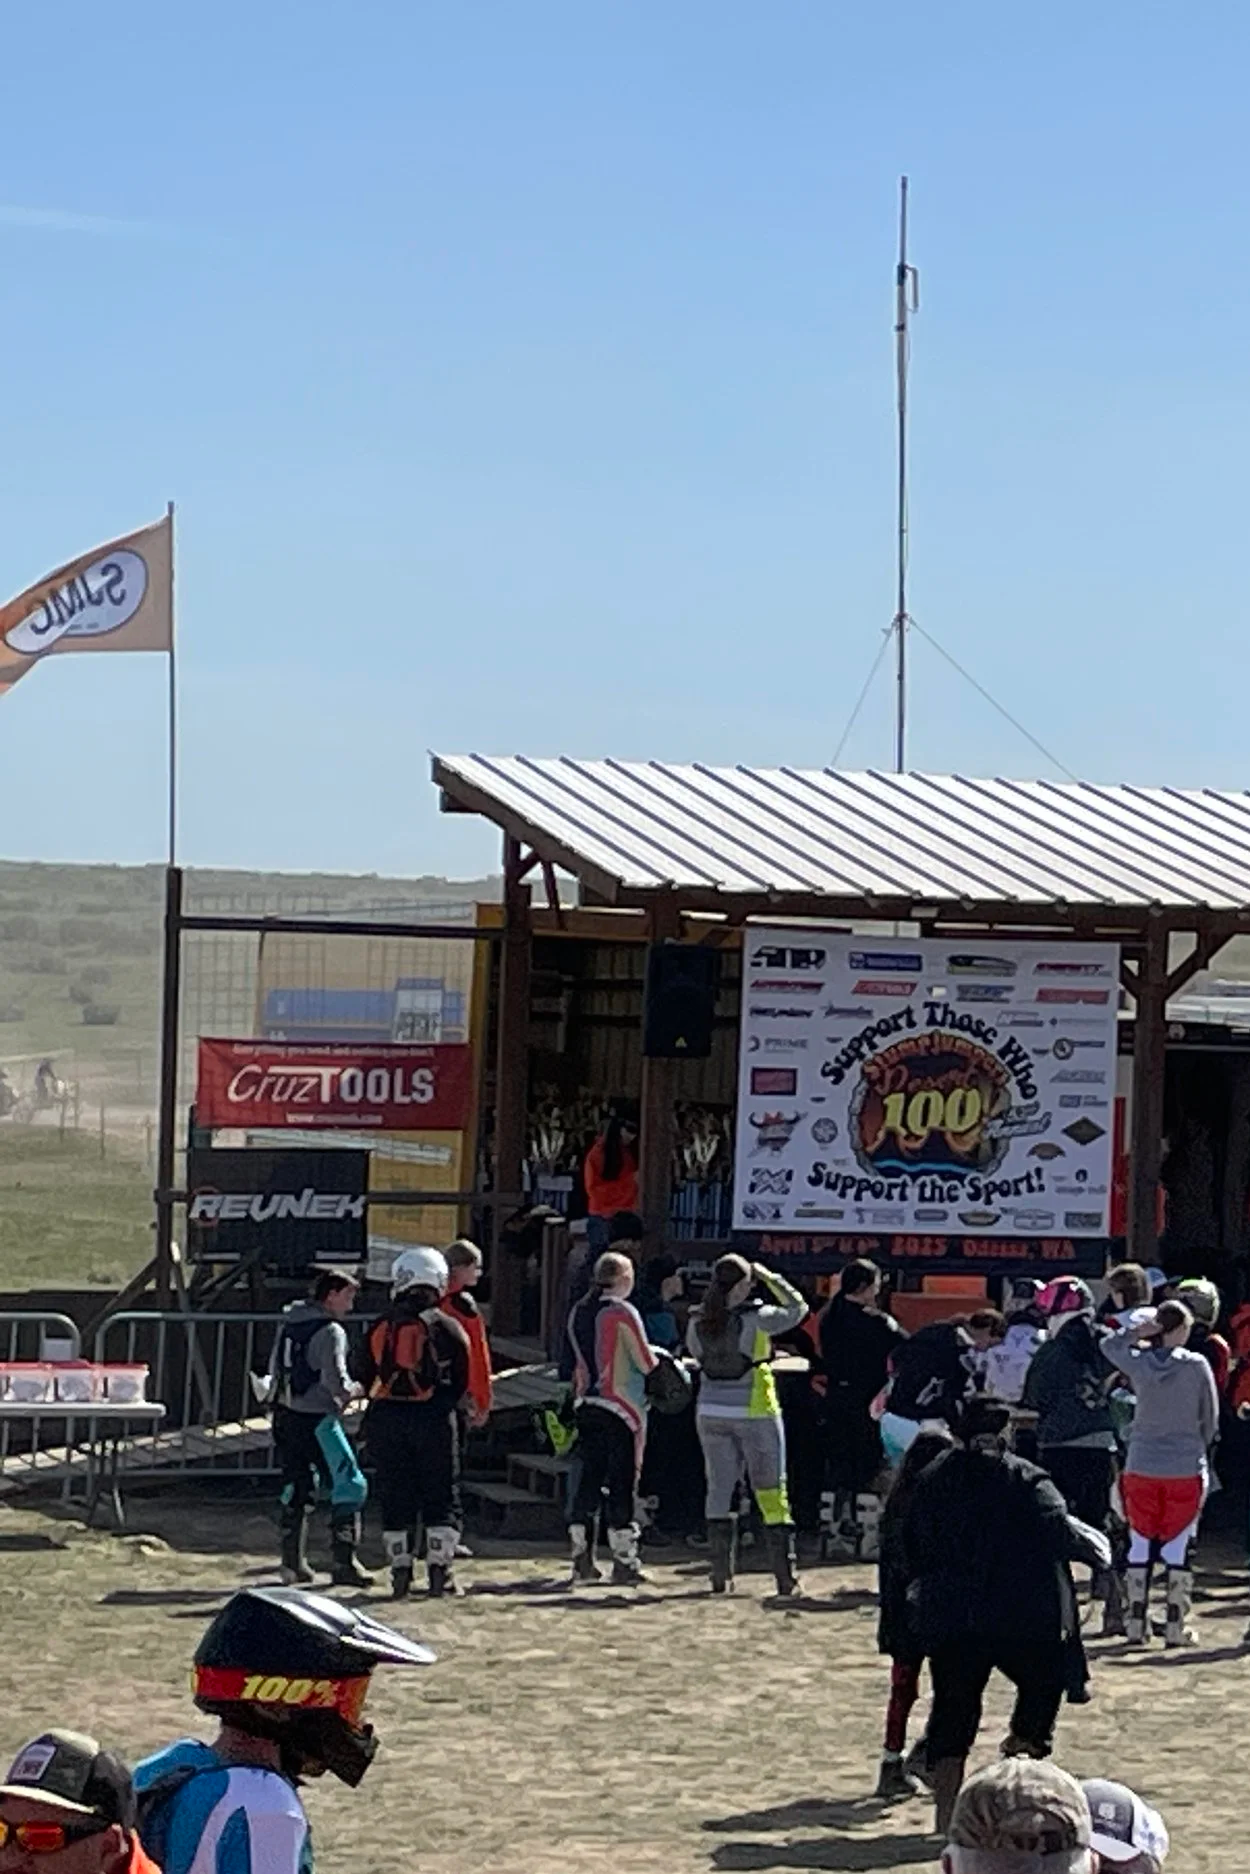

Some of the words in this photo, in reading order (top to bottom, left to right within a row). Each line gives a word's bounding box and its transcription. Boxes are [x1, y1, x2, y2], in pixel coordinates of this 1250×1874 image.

[821, 1005, 917, 1085] Support
[923, 1001, 998, 1045] Those
[997, 1036, 1038, 1100] Who
[227, 1064, 435, 1104] CruzTOOLS
[883, 1087, 982, 1137] 100
[807, 1161, 909, 1202] Support
[918, 1179, 960, 1203] the
[966, 1166, 1046, 1205] Sport!
[1040, 1239, 1076, 1260] WA
[240, 1674, 339, 1706] 100%
